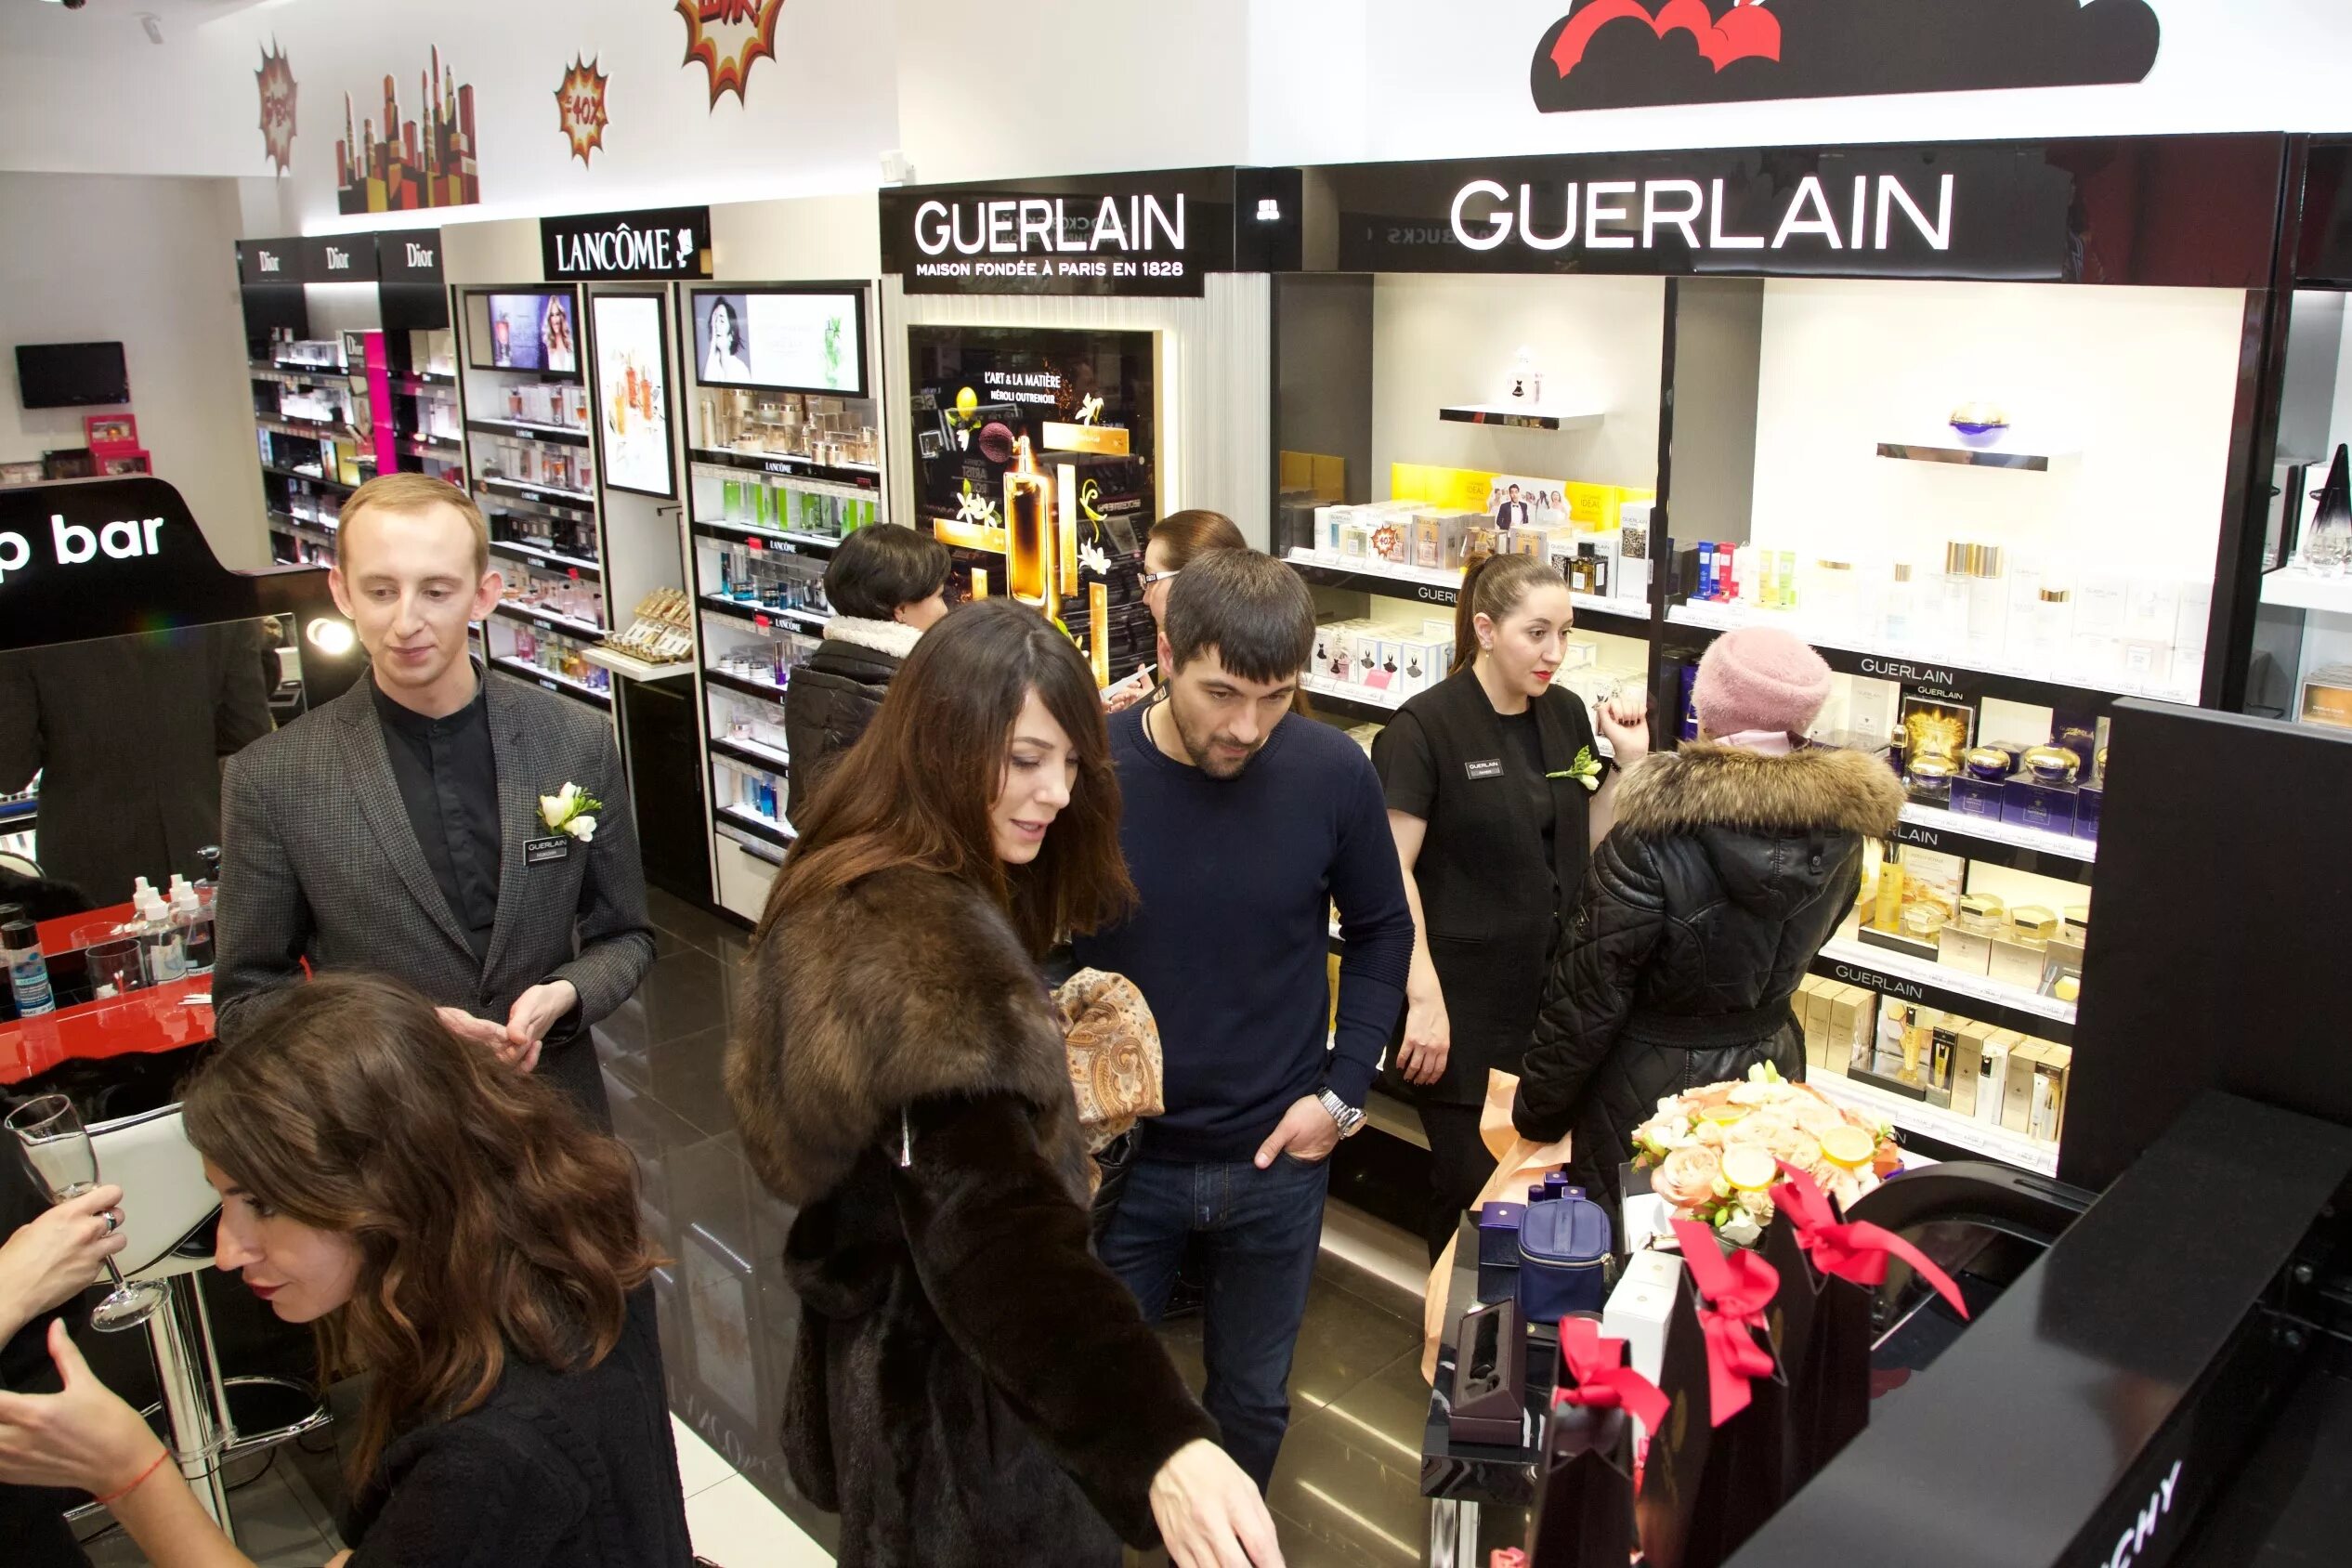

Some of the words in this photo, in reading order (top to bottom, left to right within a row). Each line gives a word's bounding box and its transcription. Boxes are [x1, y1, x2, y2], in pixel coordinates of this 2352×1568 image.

[1450, 174, 1954, 251] GUERLAIN
[914, 192, 1185, 255] GUERLAIN
[406, 242, 434, 268] Dior
[555, 222, 673, 271] LANCÔME
[259, 251, 280, 271] Dior
[326, 247, 349, 269] Dior
[916, 263, 971, 277] MAISON
[975, 260, 1037, 277] FONDÉE
[1042, 259, 1052, 276] À
[1059, 262, 1106, 277] PARIS
[1114, 262, 1137, 277] EN
[1143, 262, 1183, 277] 1828
[1005, 374, 1012, 385] &
[1013, 372, 1024, 385] LA
[1015, 392, 1055, 404] OUTRENOIR
[765, 461, 792, 474] LANCÔME
[51, 514, 163, 565] bar
[770, 540, 796, 554] LANCÔME
[1418, 586, 1458, 603] GUERL
[775, 619, 802, 633] LANCÔME
[1861, 658, 1953, 686] GUERLAIN
[1917, 686, 1964, 700] GUERLAIN
[1469, 762, 1498, 770] GUERLAIN
[528, 839, 567, 850] GUERLAIN
[1894, 826, 1939, 845] LAIN
[1836, 964, 1923, 1000] GUERLAIN
[2101, 1459, 2182, 1568] CHY
